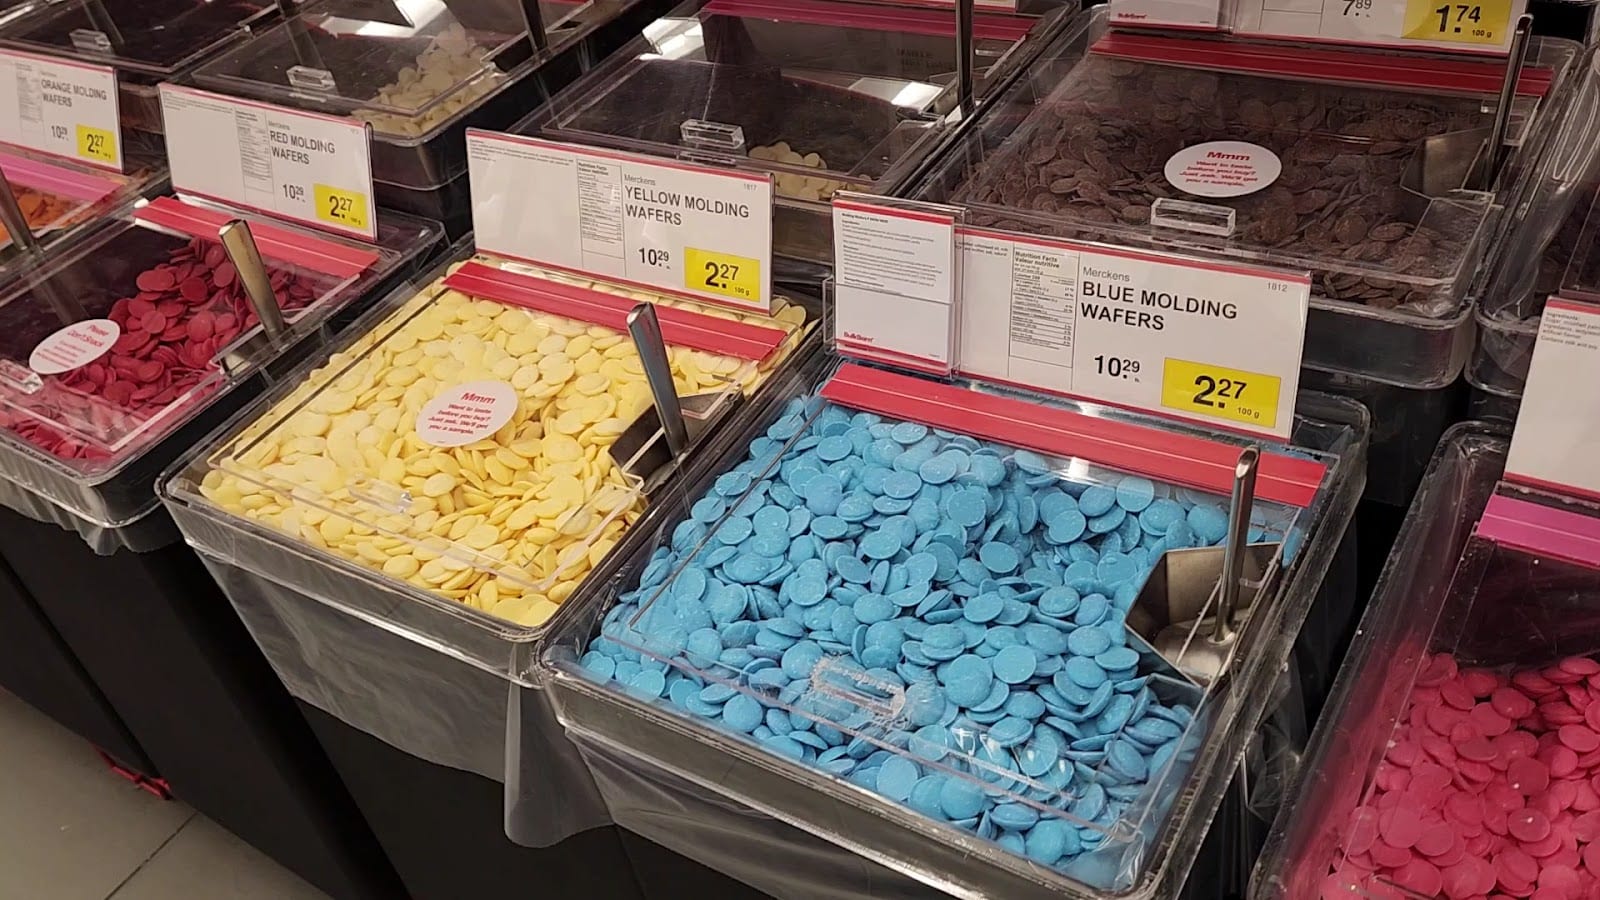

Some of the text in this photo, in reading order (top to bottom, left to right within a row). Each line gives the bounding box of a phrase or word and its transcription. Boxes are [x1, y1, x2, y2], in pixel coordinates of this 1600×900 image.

[41, 79, 107, 100] ORANGE MOLDING
[42, 93, 72, 107] WAFERS
[269, 130, 336, 154] RED MOLDING
[271, 146, 310, 165] WAFERS
[1206, 151, 1250, 161] Mmm
[624, 174, 656, 186] Merckens
[625, 185, 750, 218] YELLOW MOLDING
[625, 203, 682, 226] WAFERS
[1083, 266, 1130, 282] Merckens
[1083, 281, 1237, 319] BLUE MOLDING
[1081, 302, 1165, 331] WAFERS
[461, 392, 496, 404] Mmm
[1237, 406, 1260, 419] 100 g
